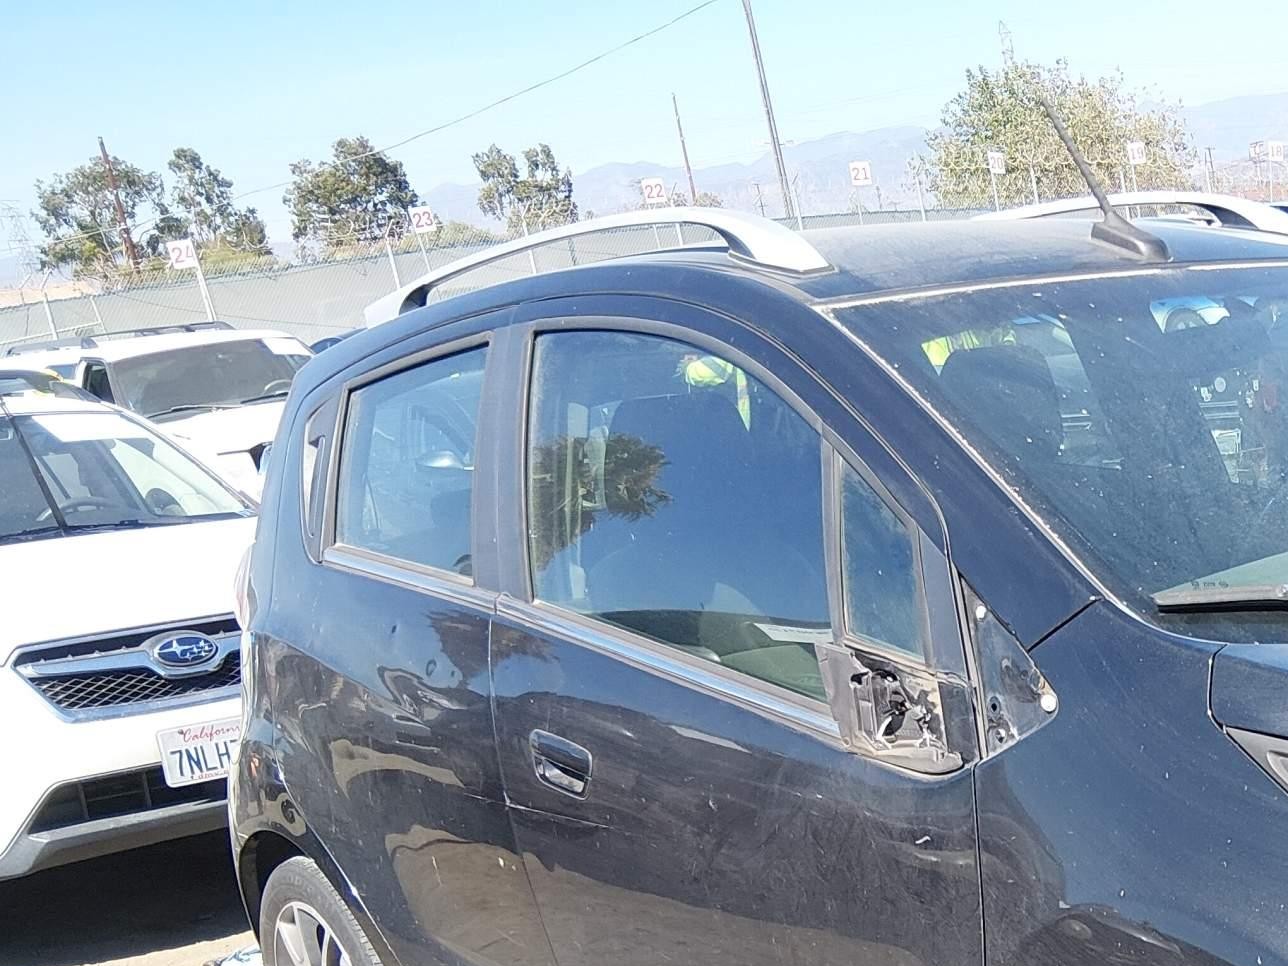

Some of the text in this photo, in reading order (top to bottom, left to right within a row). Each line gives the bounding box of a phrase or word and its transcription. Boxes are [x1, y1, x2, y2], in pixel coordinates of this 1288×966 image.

[852, 167, 870, 180] 21
[645, 184, 664, 198] 22
[413, 211, 433, 228] 23
